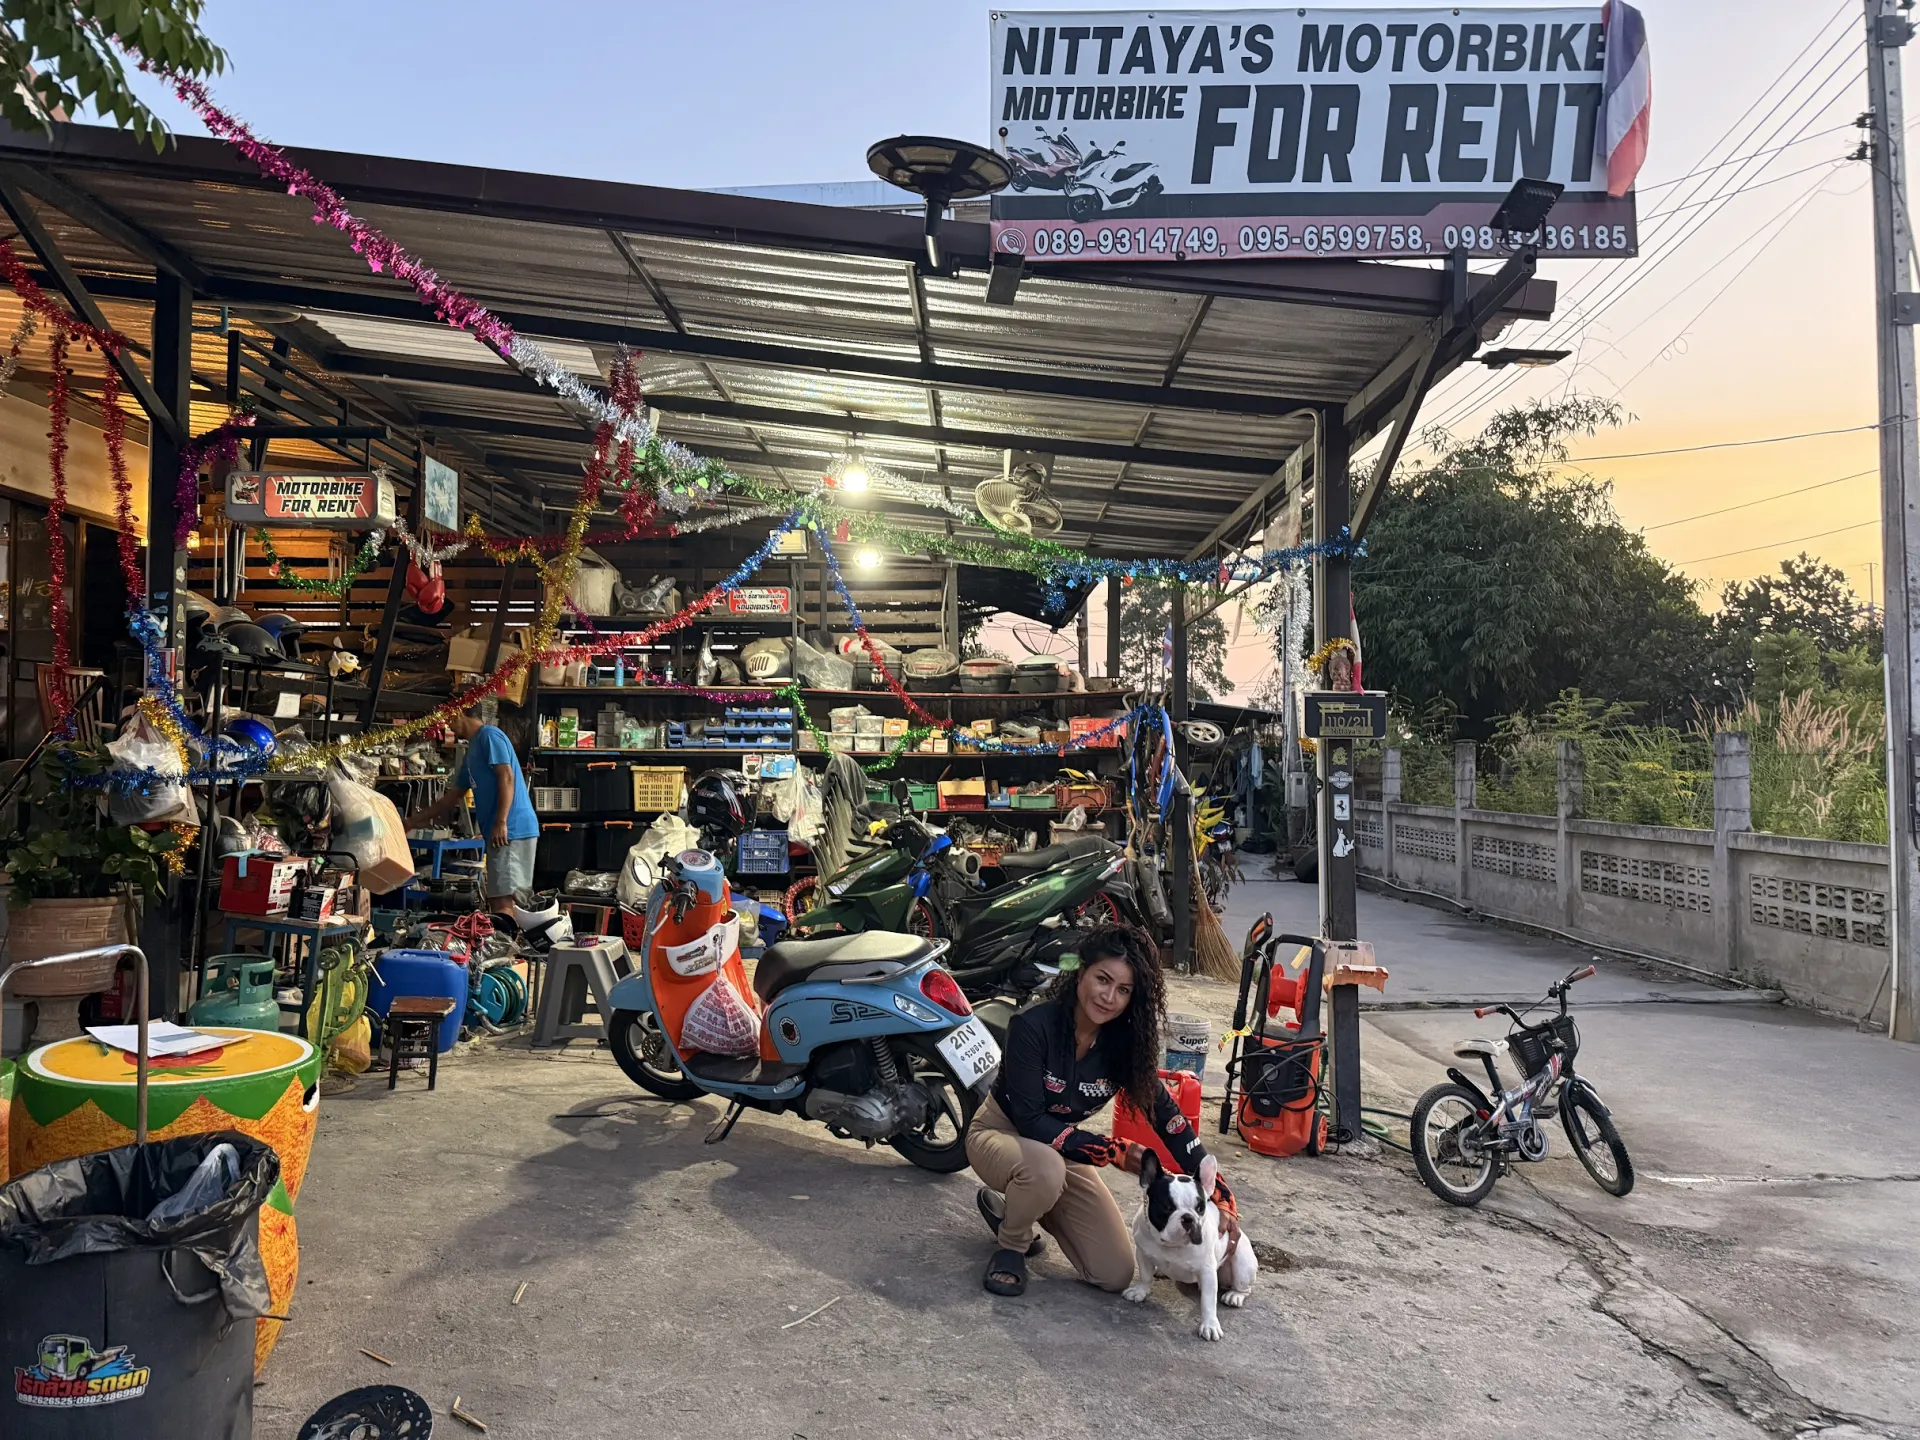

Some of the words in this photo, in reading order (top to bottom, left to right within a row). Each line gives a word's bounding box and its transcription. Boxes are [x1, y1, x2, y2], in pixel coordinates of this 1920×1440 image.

[1002, 23, 1274, 75] NITTAYA'S
[1297, 22, 1606, 73] MOTORBIKE
[1002, 85, 1188, 121] MOTORBIKE
[1191, 84, 1361, 184] FOR
[1381, 82, 1603, 182] RENT
[1033, 227, 1227, 256] 089-9314749,
[1238, 224, 1431, 254] 095-6599758,
[276, 482, 364, 496] MOTORBIKE
[281, 499, 311, 513] FOR
[316, 499, 360, 513] RENT
[749, 656, 769, 673] 300
[1327, 716, 1366, 728] 110/21
[972, 1051, 996, 1075] 426
